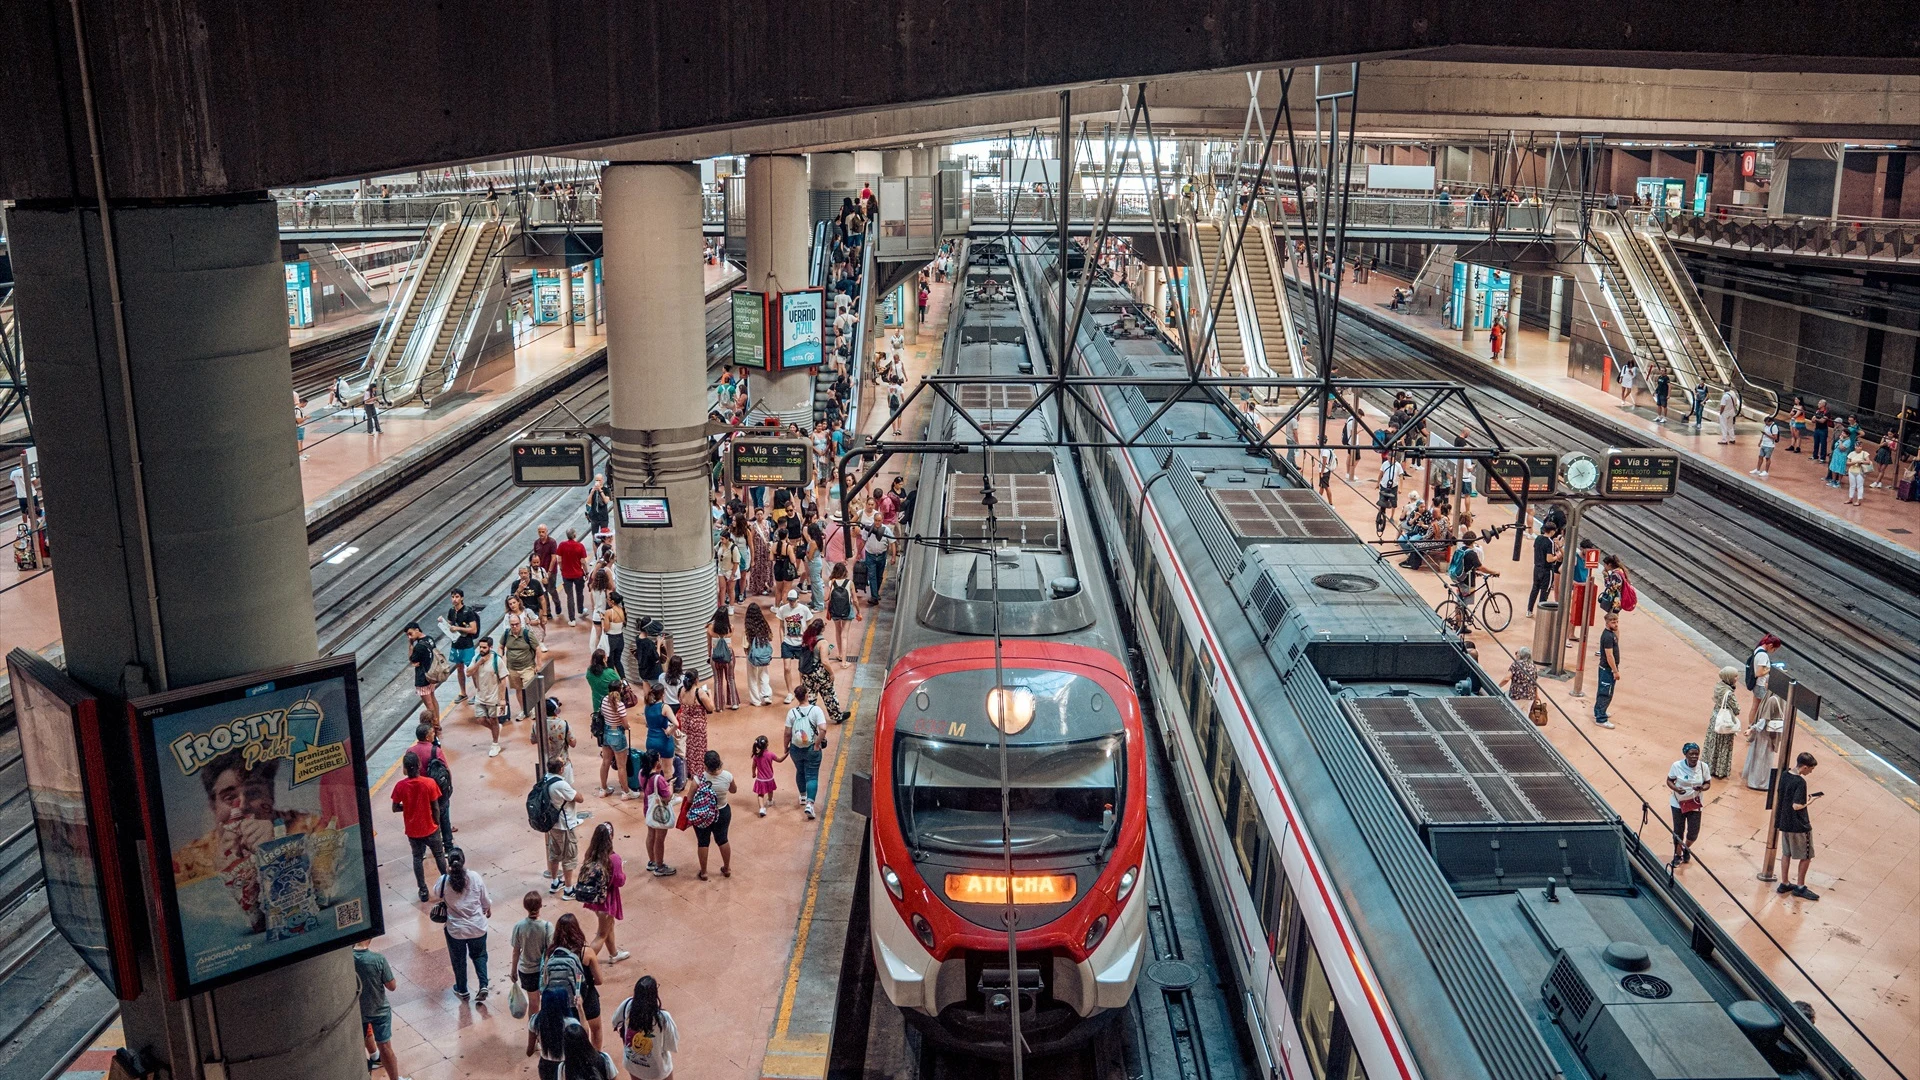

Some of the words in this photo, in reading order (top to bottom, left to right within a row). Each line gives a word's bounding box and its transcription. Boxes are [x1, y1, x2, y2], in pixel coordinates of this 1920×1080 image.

[789, 308, 816, 323] VERANO
[792, 322, 814, 340] AZUL
[172, 710, 285, 771] FROSTY
[243, 738, 295, 770] Pocket
[297, 745, 340, 764] granizado
[304, 752, 342, 767] instantáneo
[298, 758, 343, 779] ¡INCREÍBLE!
[263, 840, 298, 863] FROSTY
[967, 876, 1054, 892] ATOCHA
